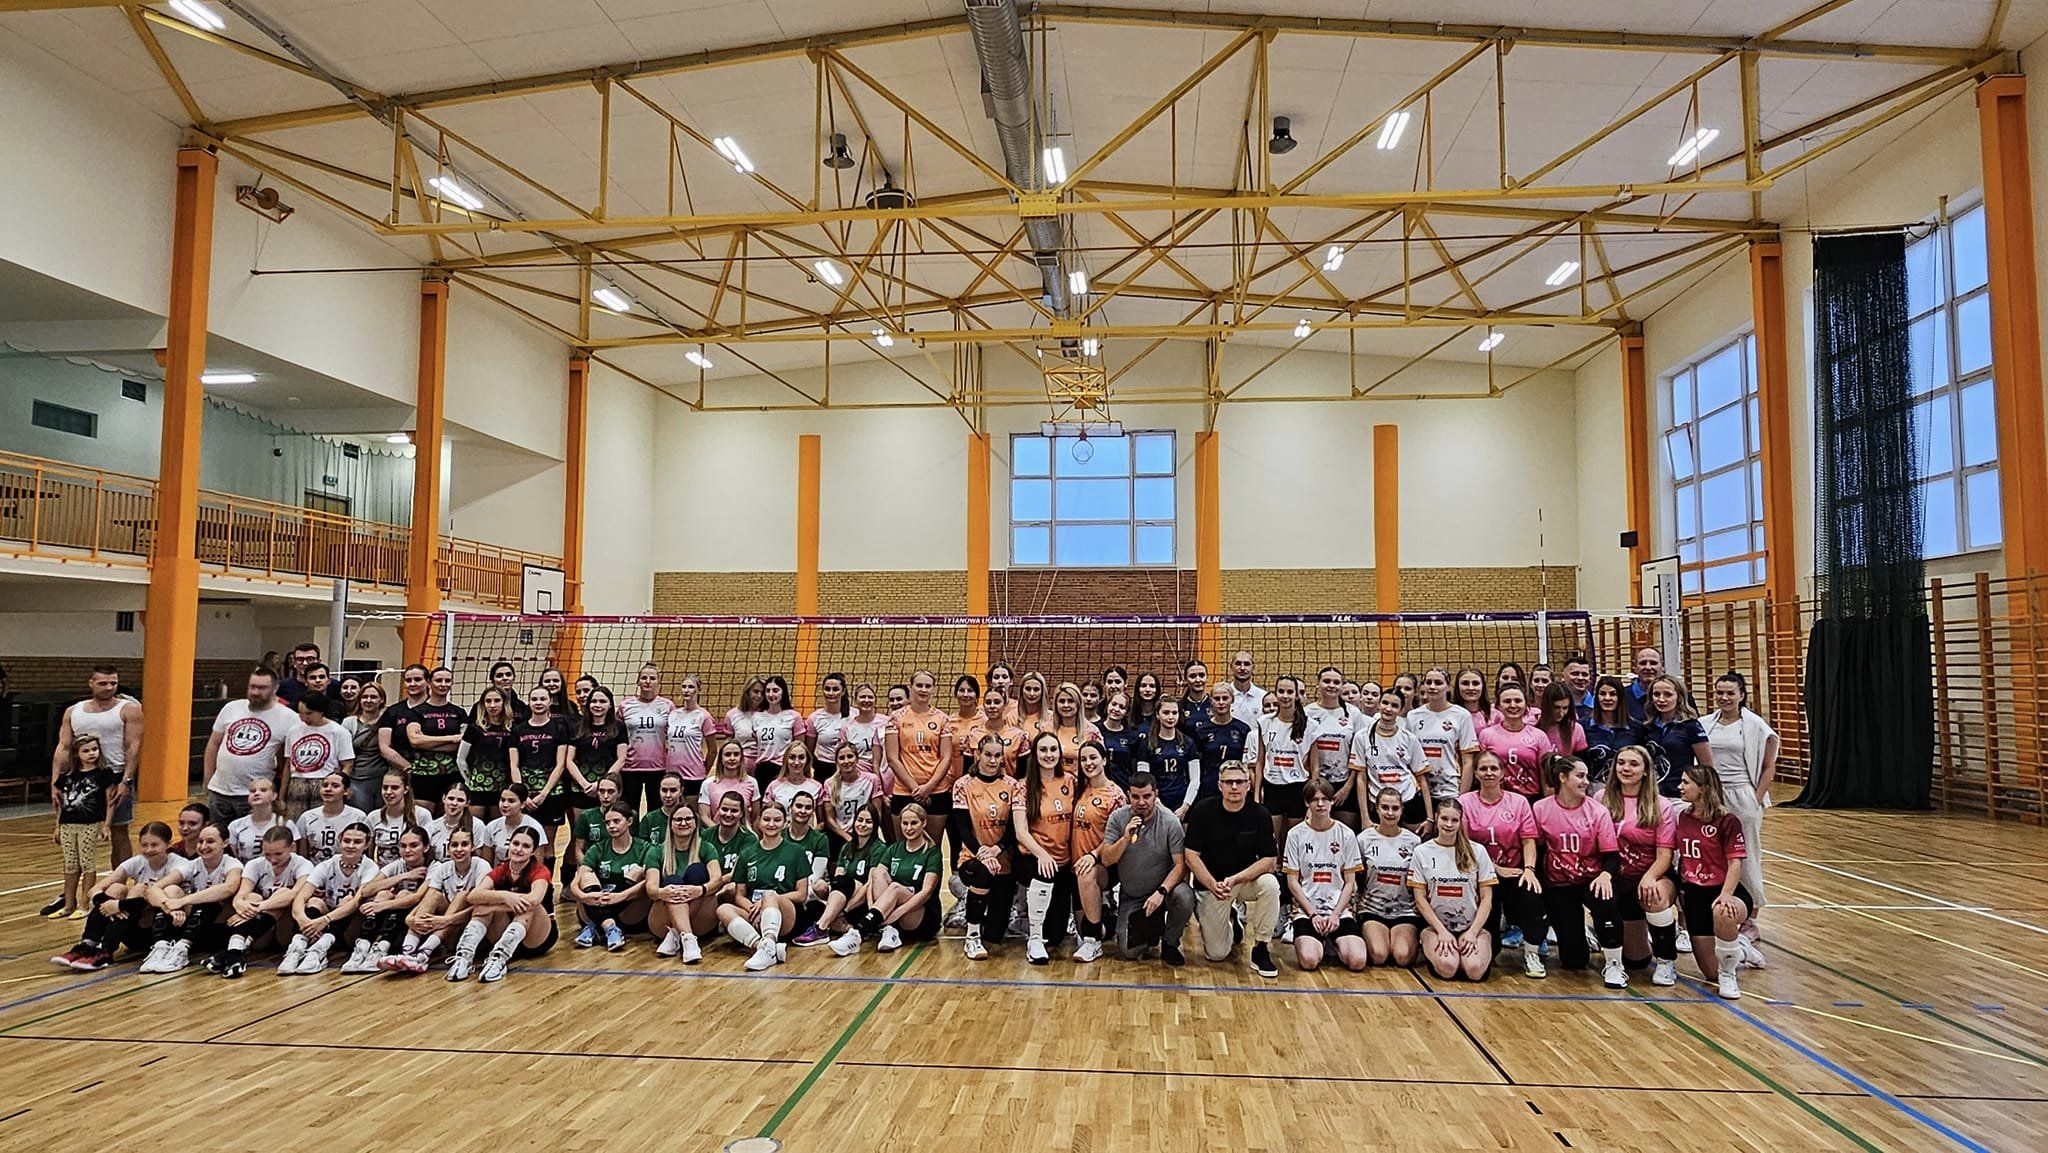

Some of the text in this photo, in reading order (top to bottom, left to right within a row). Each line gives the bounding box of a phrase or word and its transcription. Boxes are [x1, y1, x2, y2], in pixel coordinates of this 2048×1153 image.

[437, 719, 445, 729] 8
[639, 716, 654, 729] 10
[1419, 720, 1424, 730] 5
[762, 727, 775, 741] 23
[1268, 732, 1276, 742] 17
[532, 740, 540, 754] 5
[1219, 745, 1227, 760] 7
[1508, 748, 1518, 765] 6
[1164, 758, 1177, 773] 12
[844, 800, 858, 816] 27
[988, 803, 997, 818] 5
[1054, 799, 1063, 812] 8
[321, 831, 336, 846] 18
[389, 831, 399, 845] 9
[1487, 827, 1498, 845] 1
[1560, 833, 1580, 853] 10
[1305, 842, 1313, 854] 14
[1683, 838, 1700, 858] 16
[774, 865, 786, 882] 4
[856, 860, 865, 876] 9
[912, 864, 923, 881] 7
